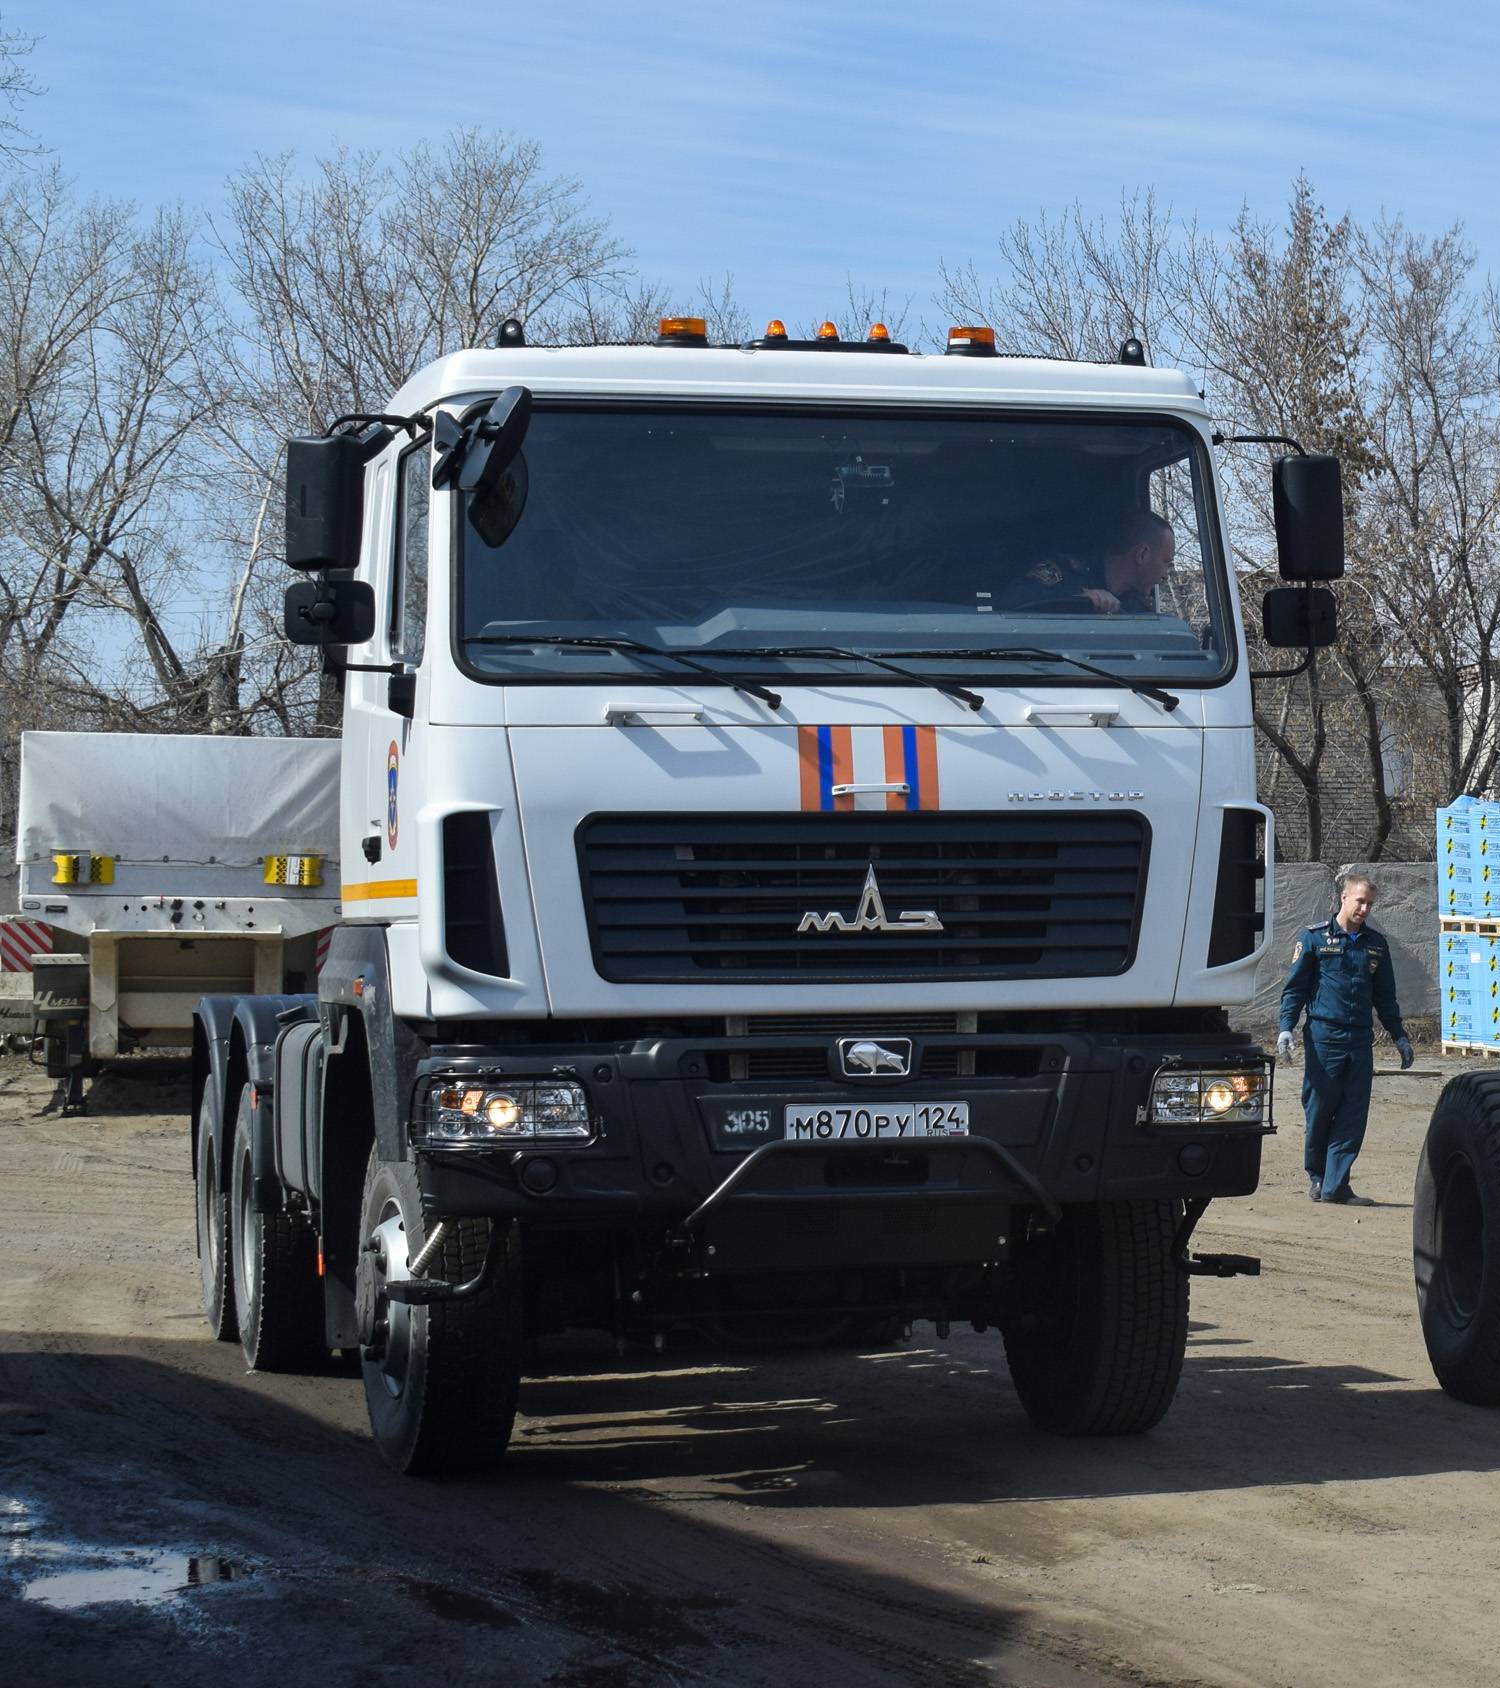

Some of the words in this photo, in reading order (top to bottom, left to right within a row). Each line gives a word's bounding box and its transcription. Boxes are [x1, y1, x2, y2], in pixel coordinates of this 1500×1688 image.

[795, 1109, 911, 1138] М870РУ
[918, 1106, 960, 1130] 124
[926, 1128, 948, 1137] RUS
